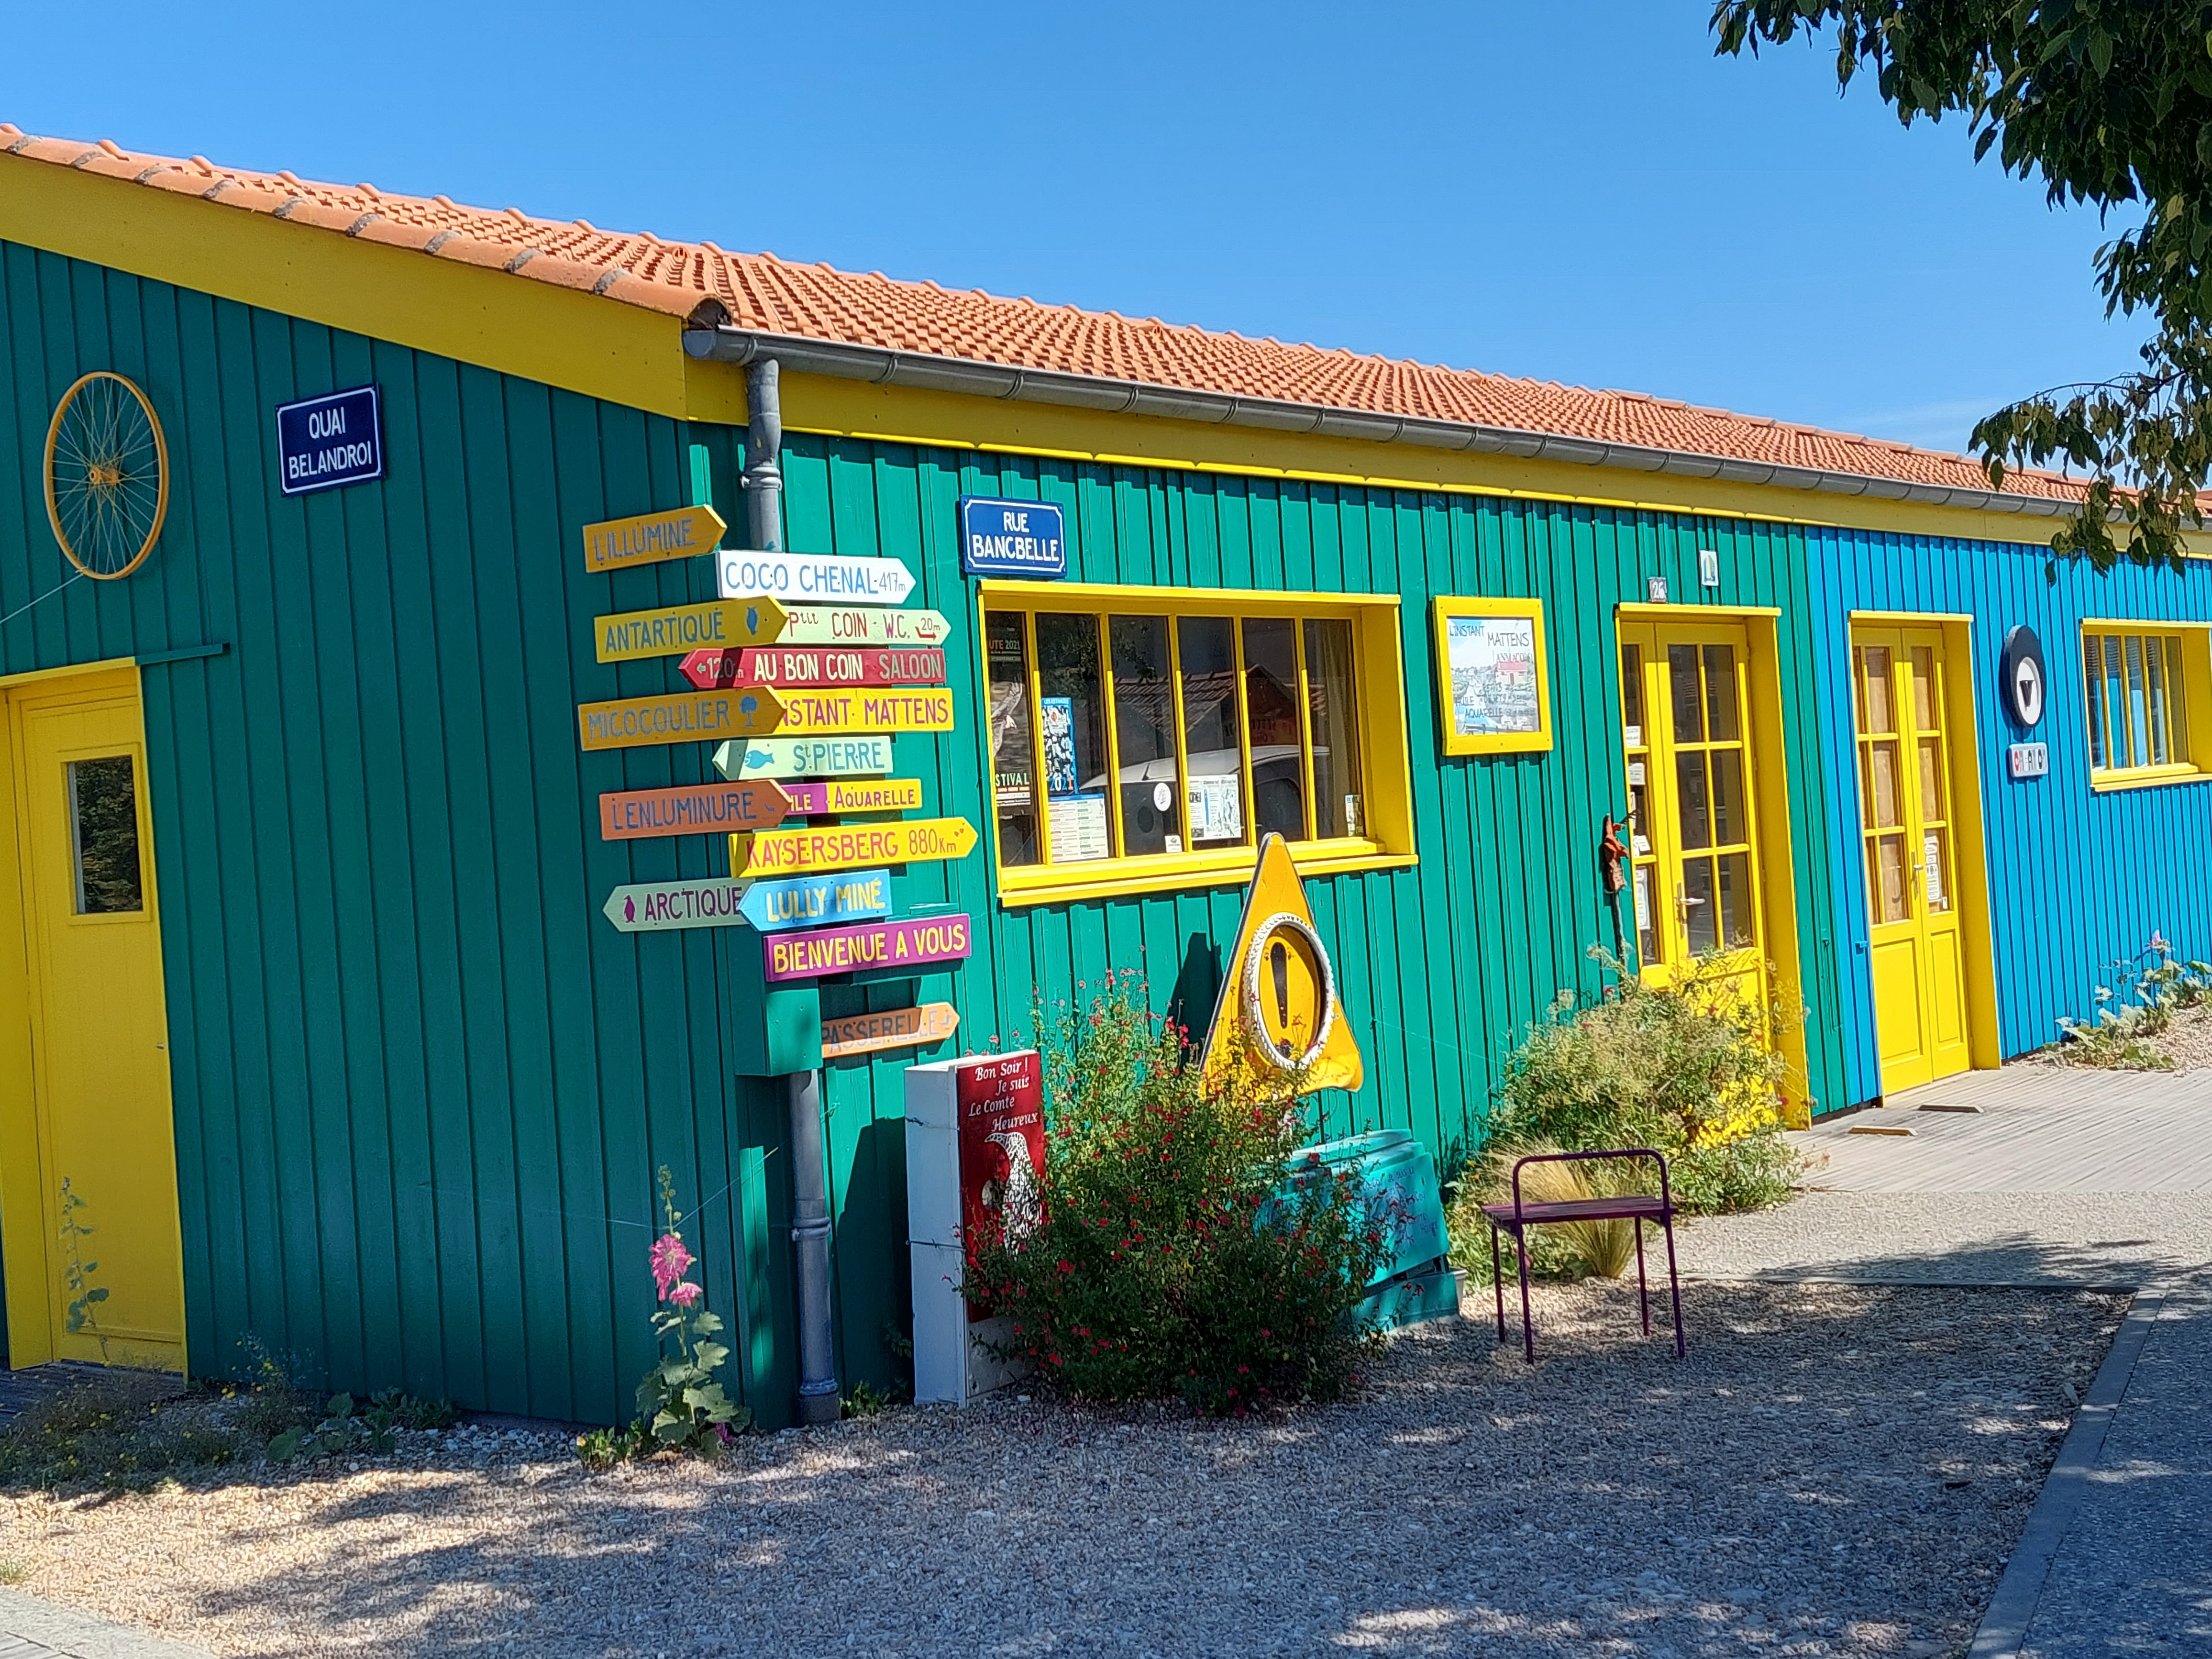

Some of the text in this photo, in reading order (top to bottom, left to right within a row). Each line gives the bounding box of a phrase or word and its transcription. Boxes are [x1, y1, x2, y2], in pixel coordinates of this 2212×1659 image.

[309, 406, 346, 439] QUAI
[288, 440, 372, 479] BELANDROI
[1003, 511, 1029, 533] RUE
[973, 535, 1060, 562] BANCBELLE
[726, 561, 906, 595] COCO CHENAL 417m
[605, 611, 726, 653] ANTARTIQUE
[832, 612, 867, 638] COIN
[883, 613, 910, 639] W.C.
[920, 617, 940, 631] 20m
[1487, 632, 1529, 647] MATTENS
[1005, 639, 1021, 650] 2021
[754, 653, 777, 681] AU
[784, 653, 819, 681] BON
[826, 653, 864, 681] COIN
[879, 653, 942, 679] SALOON
[588, 699, 731, 740] MICOCOULIER
[864, 697, 949, 726] MATTENS
[1049, 776, 1074, 791] 2021
[612, 791, 757, 830] L'ENLUMINURE
[745, 831, 899, 869] KAYSERSBERG
[644, 886, 742, 922] ARCTIQUE
[766, 886, 827, 922] LULLY
[774, 924, 966, 974] BIENVENUE A VOUS
[822, 1009, 940, 1053] PASSERELLE
[974, 1067, 996, 1082] Bon
[1000, 1060, 1022, 1076] Soir
[995, 1074, 1030, 1096] Je suis
[968, 1095, 1015, 1117] Le Comte
[991, 1112, 1039, 1133] Heureux
